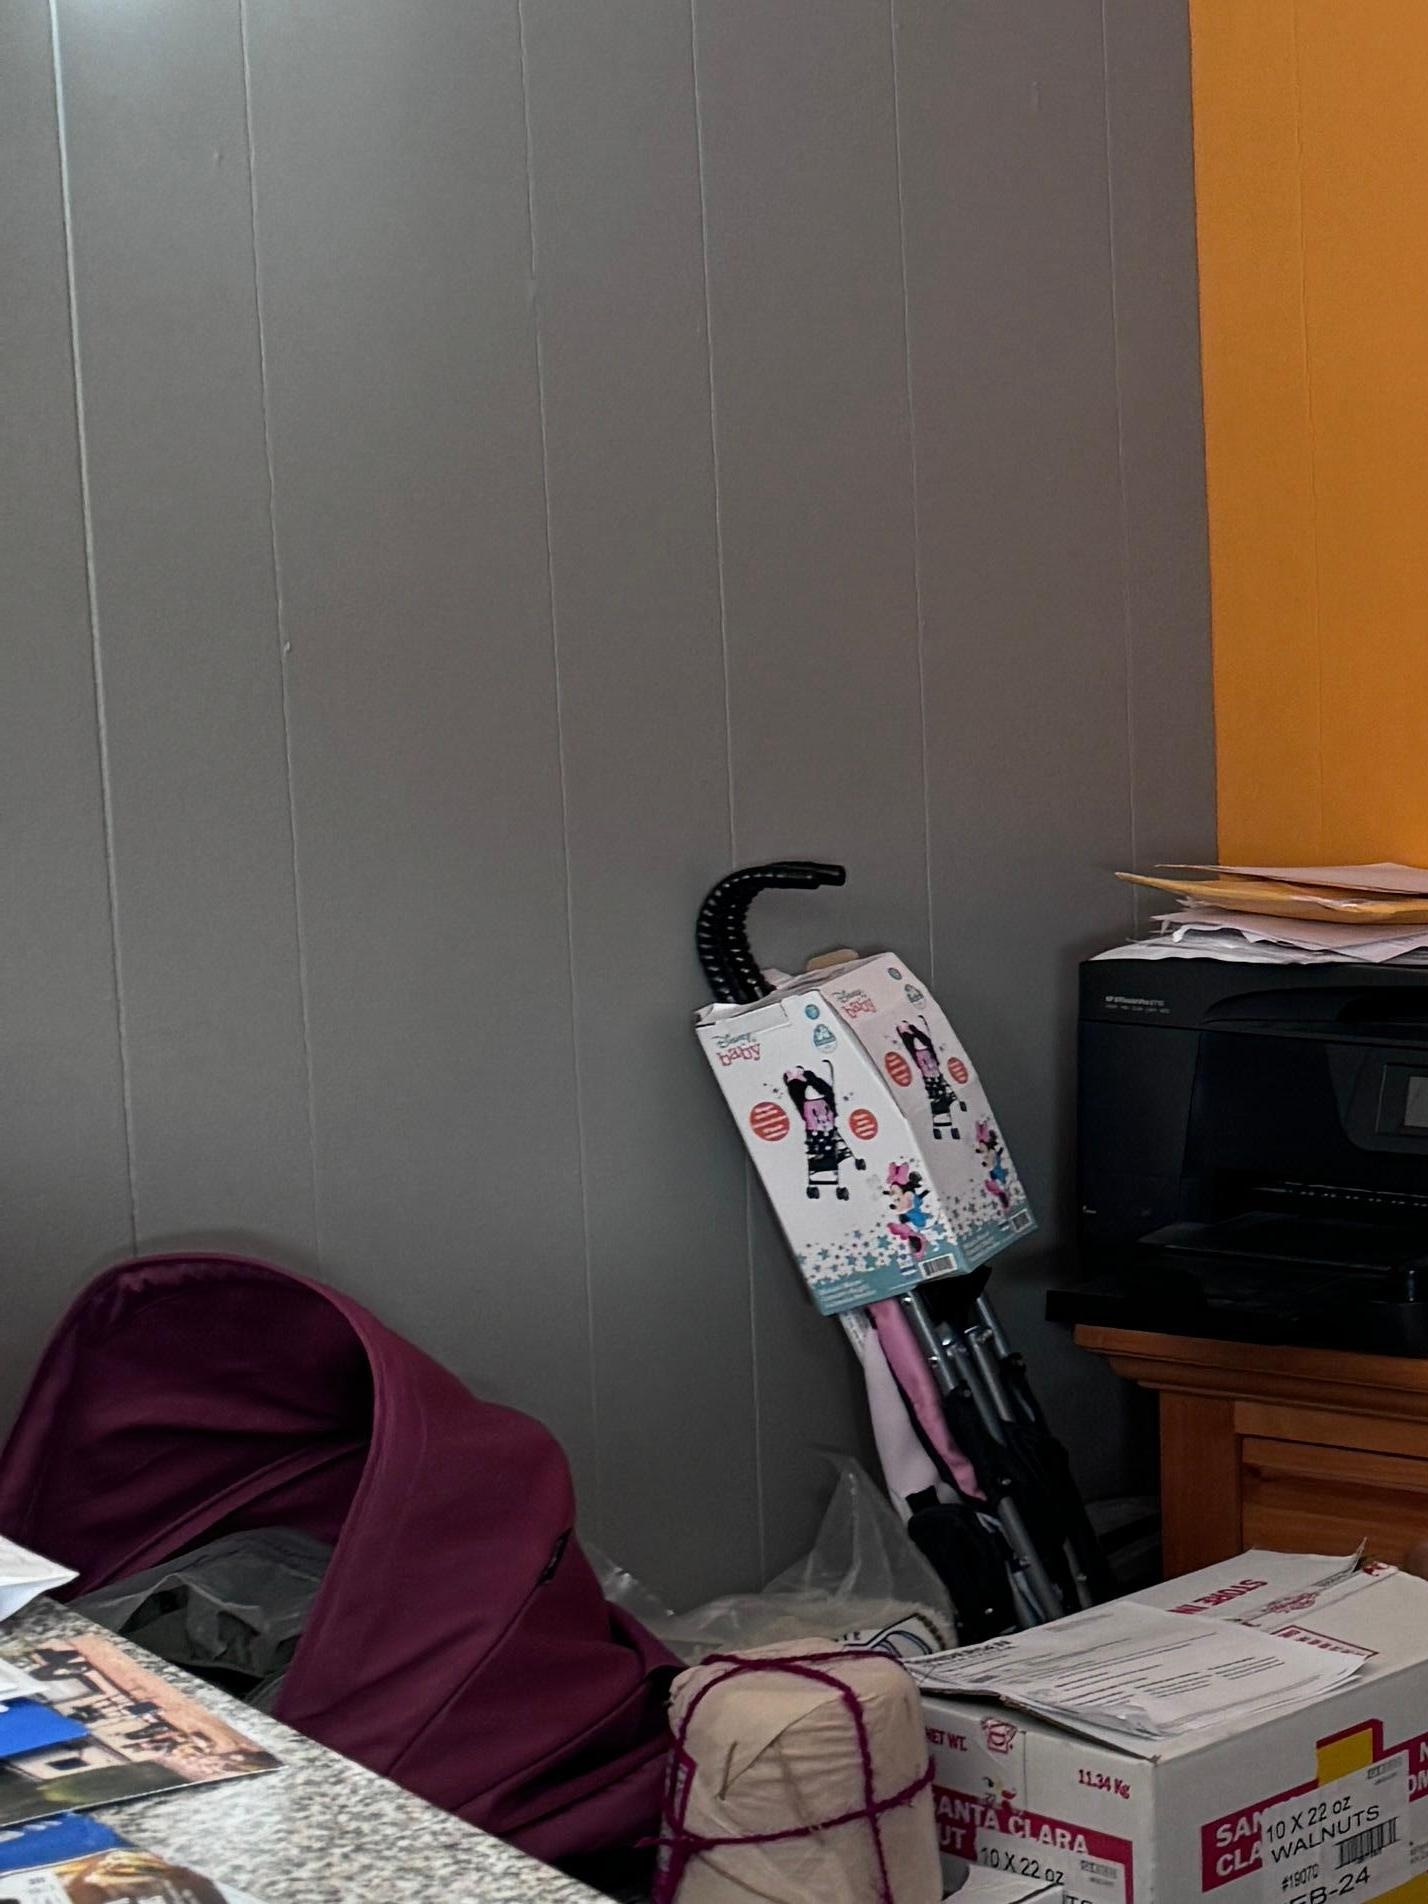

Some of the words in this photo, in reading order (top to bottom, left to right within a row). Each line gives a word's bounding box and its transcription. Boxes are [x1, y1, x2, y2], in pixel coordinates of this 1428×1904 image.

[1193, 1578, 1268, 1610] STORE
[1078, 1768, 1112, 1791] 11.34
[936, 1796, 1001, 1831] ANTA
[1007, 1815, 1090, 1856] CLARA
[938, 1823, 968, 1850] UT
[1266, 1818, 1287, 1844] 10
[1290, 1813, 1305, 1833] X
[1308, 1802, 1328, 1824] 22
[1270, 1803, 1381, 1865] WALNUTS
[980, 1846, 1001, 1868] 10
[1003, 1852, 1018, 1874] X
[1021, 1857, 1041, 1881] 22
[1215, 1839, 1264, 1877] CLA
